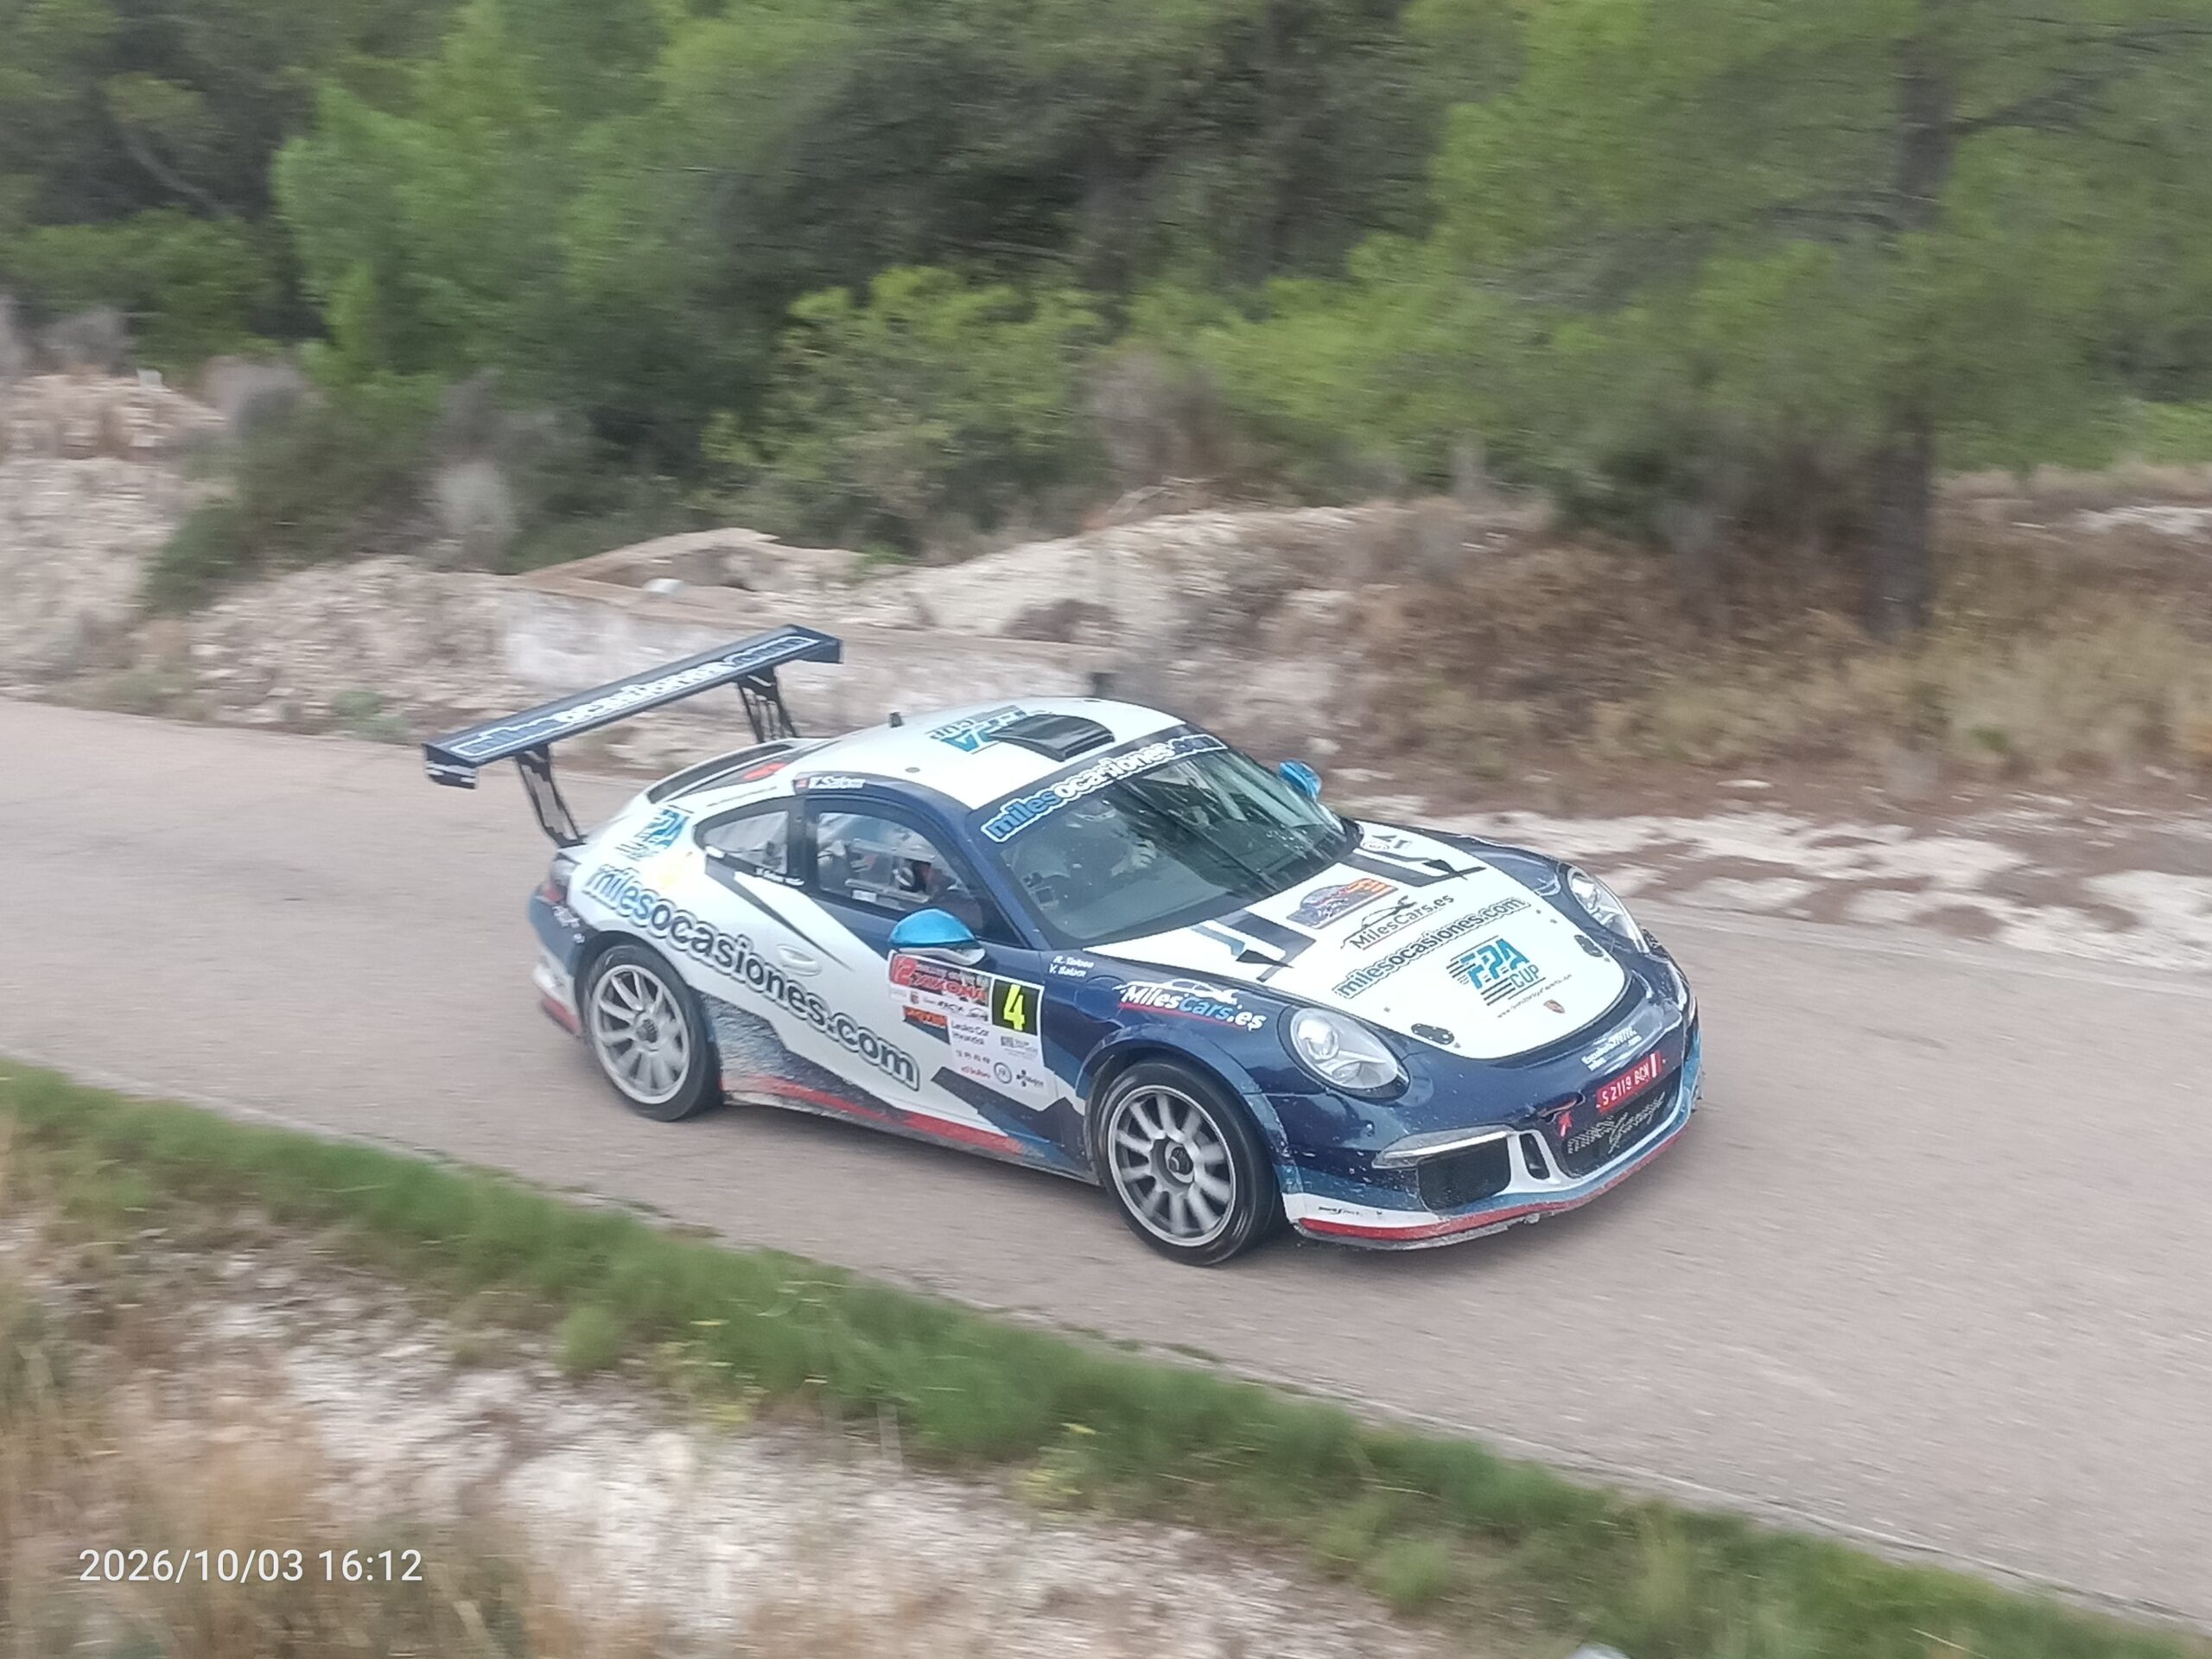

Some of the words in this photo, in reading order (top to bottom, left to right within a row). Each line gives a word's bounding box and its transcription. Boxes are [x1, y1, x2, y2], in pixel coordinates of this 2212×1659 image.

[1350, 895, 1454, 949] MilesCars.es
[1337, 899, 1527, 997] milesocasiones.com
[583, 864, 918, 1089] milesocasiones.com
[1509, 964, 1540, 988] CUP
[1002, 983, 1026, 1032] 4
[1601, 1090, 1609, 1106] S
[1610, 1076, 1632, 1101] 2119
